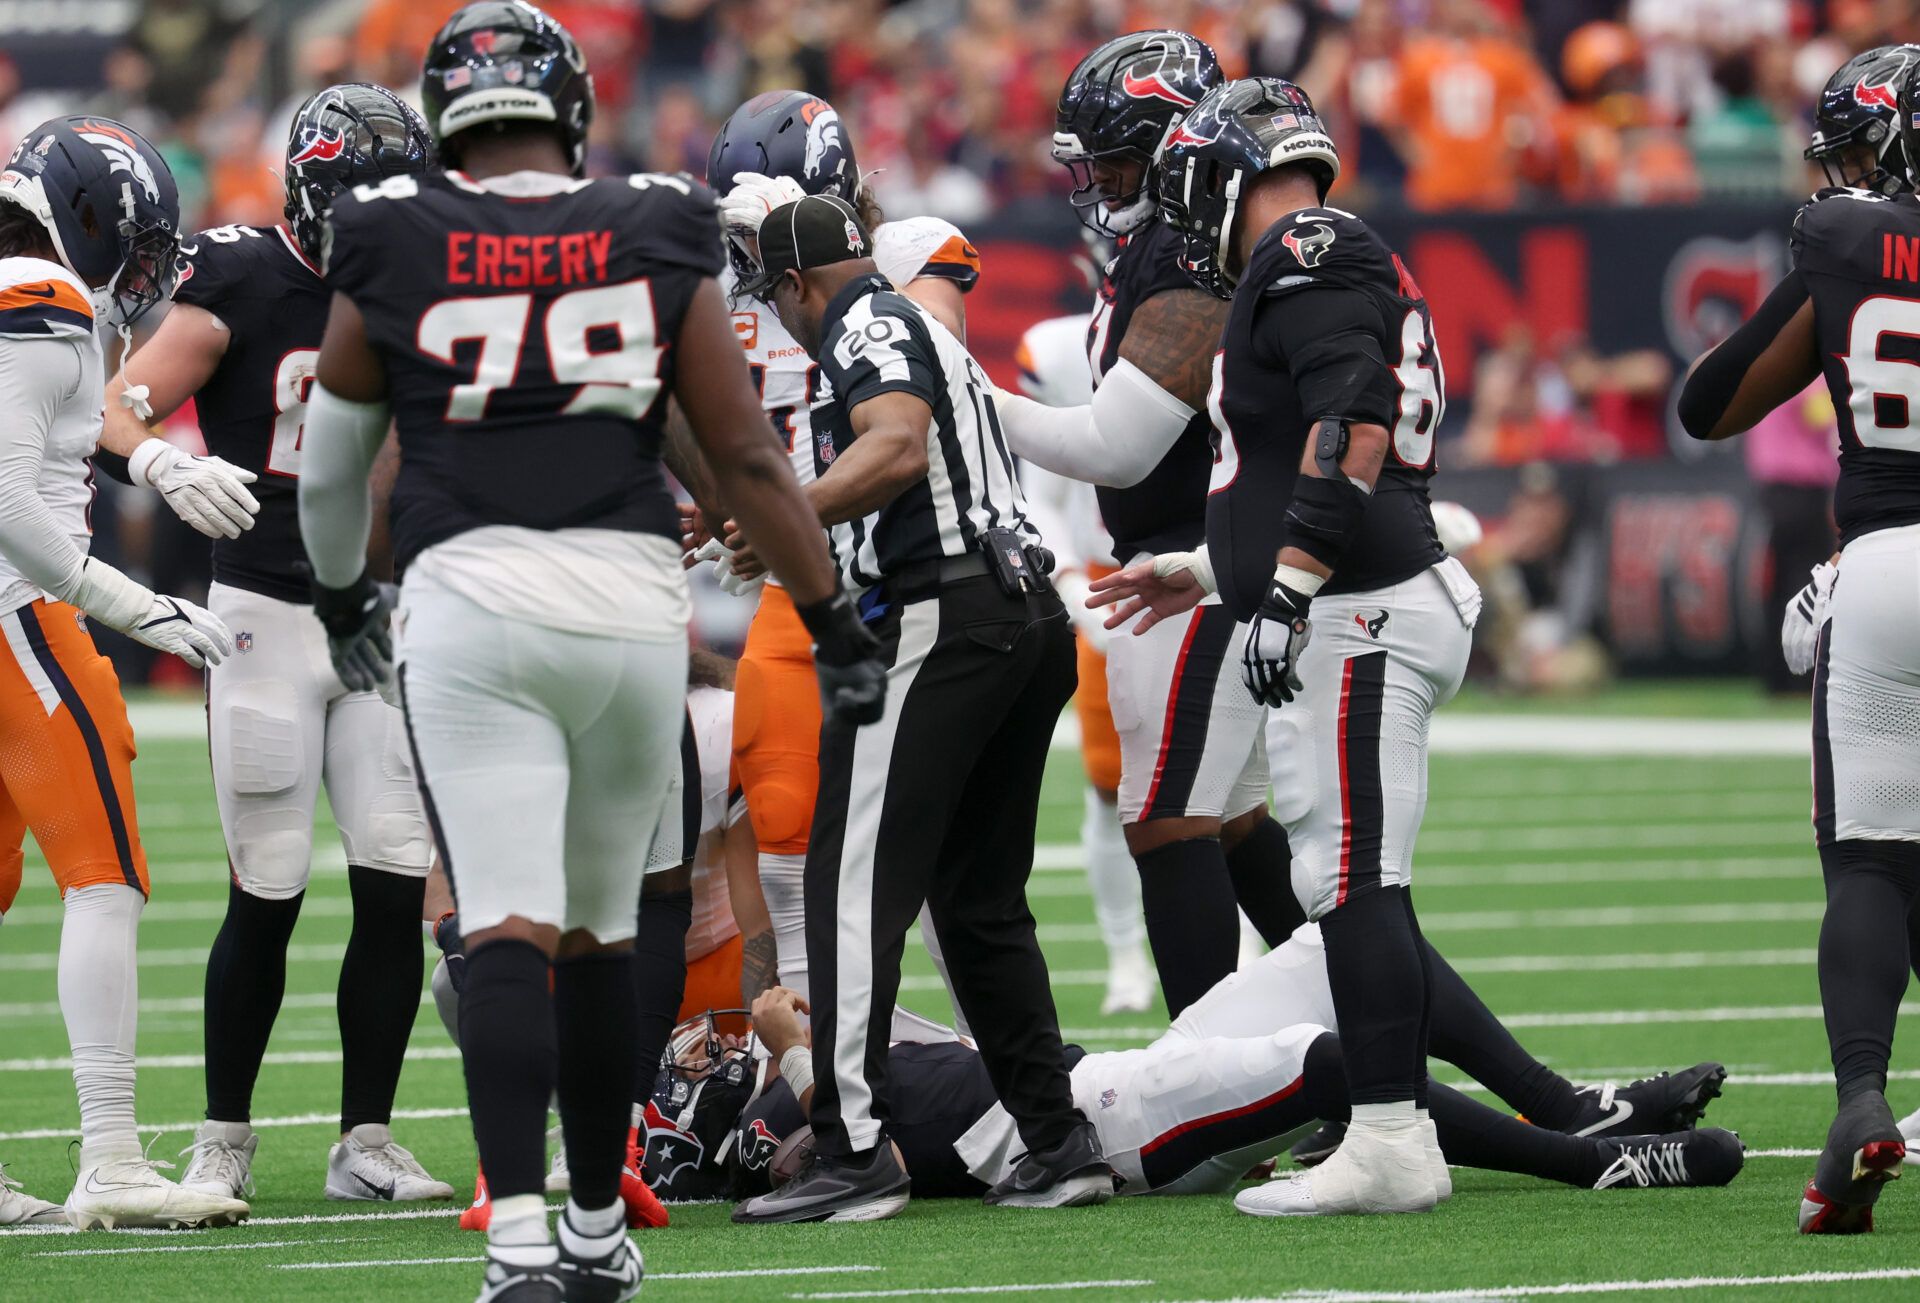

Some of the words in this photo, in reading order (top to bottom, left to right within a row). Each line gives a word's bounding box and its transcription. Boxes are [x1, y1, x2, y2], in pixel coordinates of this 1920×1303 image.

[448, 231, 613, 287] ERSERY
[416, 276, 669, 422] 79
[842, 319, 893, 358] 20
